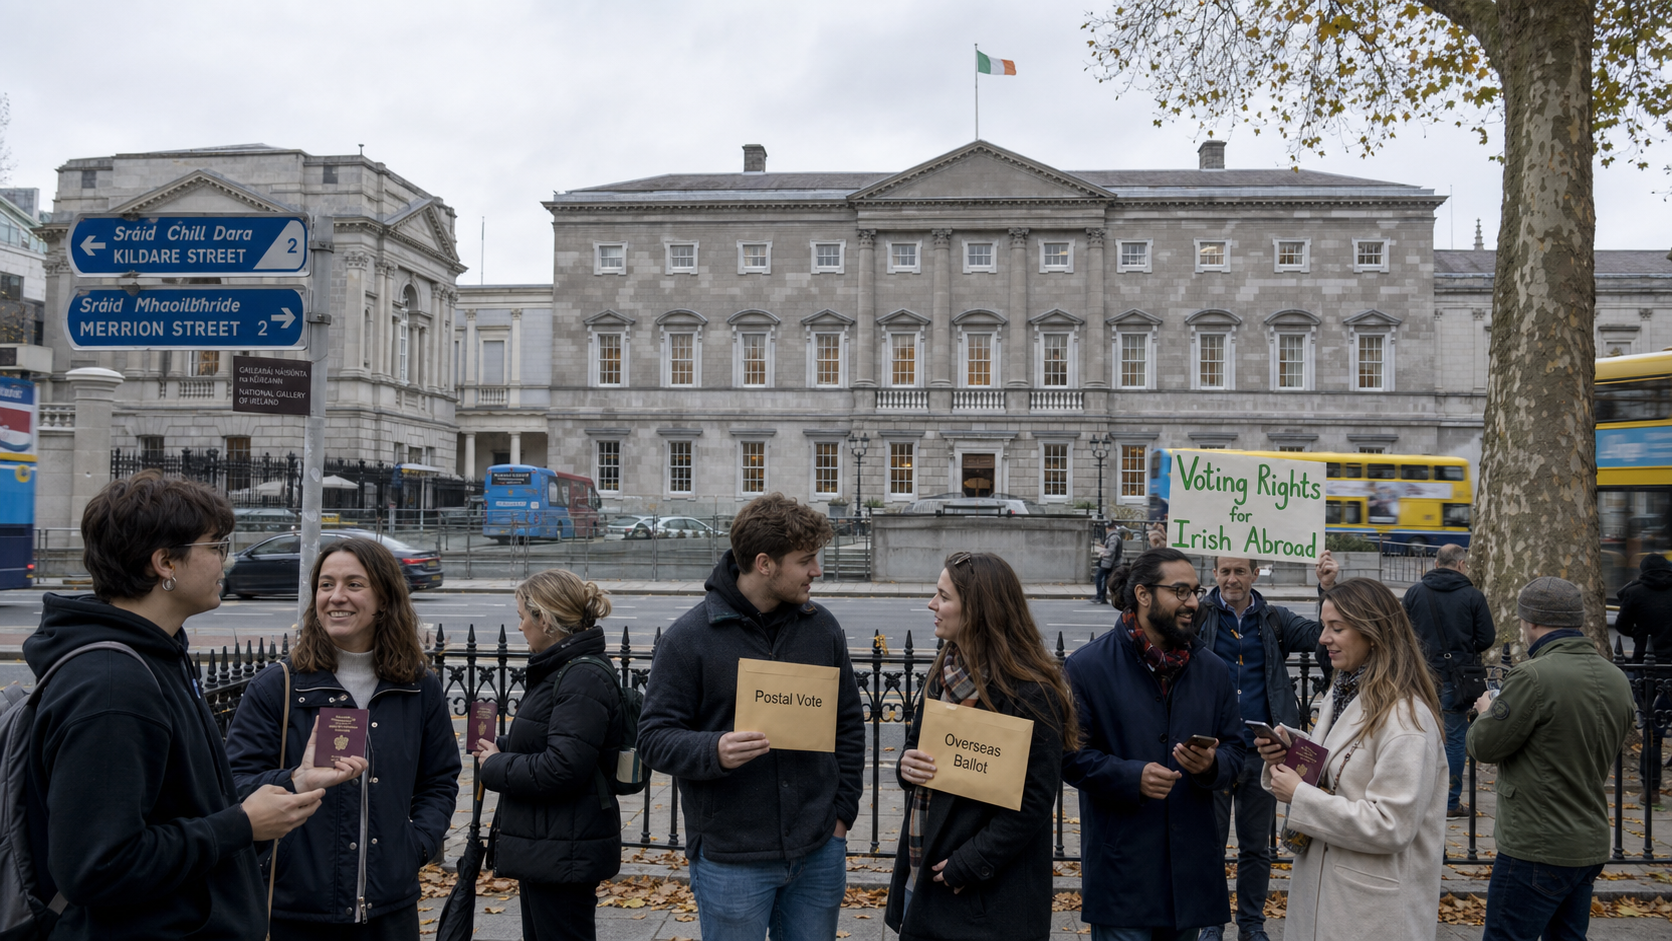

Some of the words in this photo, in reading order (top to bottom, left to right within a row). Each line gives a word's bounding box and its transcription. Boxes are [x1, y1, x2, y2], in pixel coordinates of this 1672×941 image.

[113, 225, 157, 241] Sráid
[213, 226, 253, 241] Dara
[286, 238, 298, 253] 2
[113, 249, 180, 264] KILDARE
[187, 249, 247, 264] STREET
[79, 297, 123, 313] Sráid
[80, 321, 164, 336] MERRION
[172, 321, 241, 336] STREET
[257, 321, 268, 336] 2
[239, 388, 274, 397] NATIONAL
[276, 390, 306, 399] GALLERY
[1176, 454, 1248, 505] Voting
[1257, 463, 1321, 510] Rights
[1229, 506, 1253, 523] for
[1171, 519, 1231, 551] Irish
[1243, 525, 1317, 559] Abroad
[755, 689, 793, 705] Postal
[796, 693, 823, 708] Vote
[944, 733, 1001, 757] Overseas
[953, 754, 988, 774] Ballot
